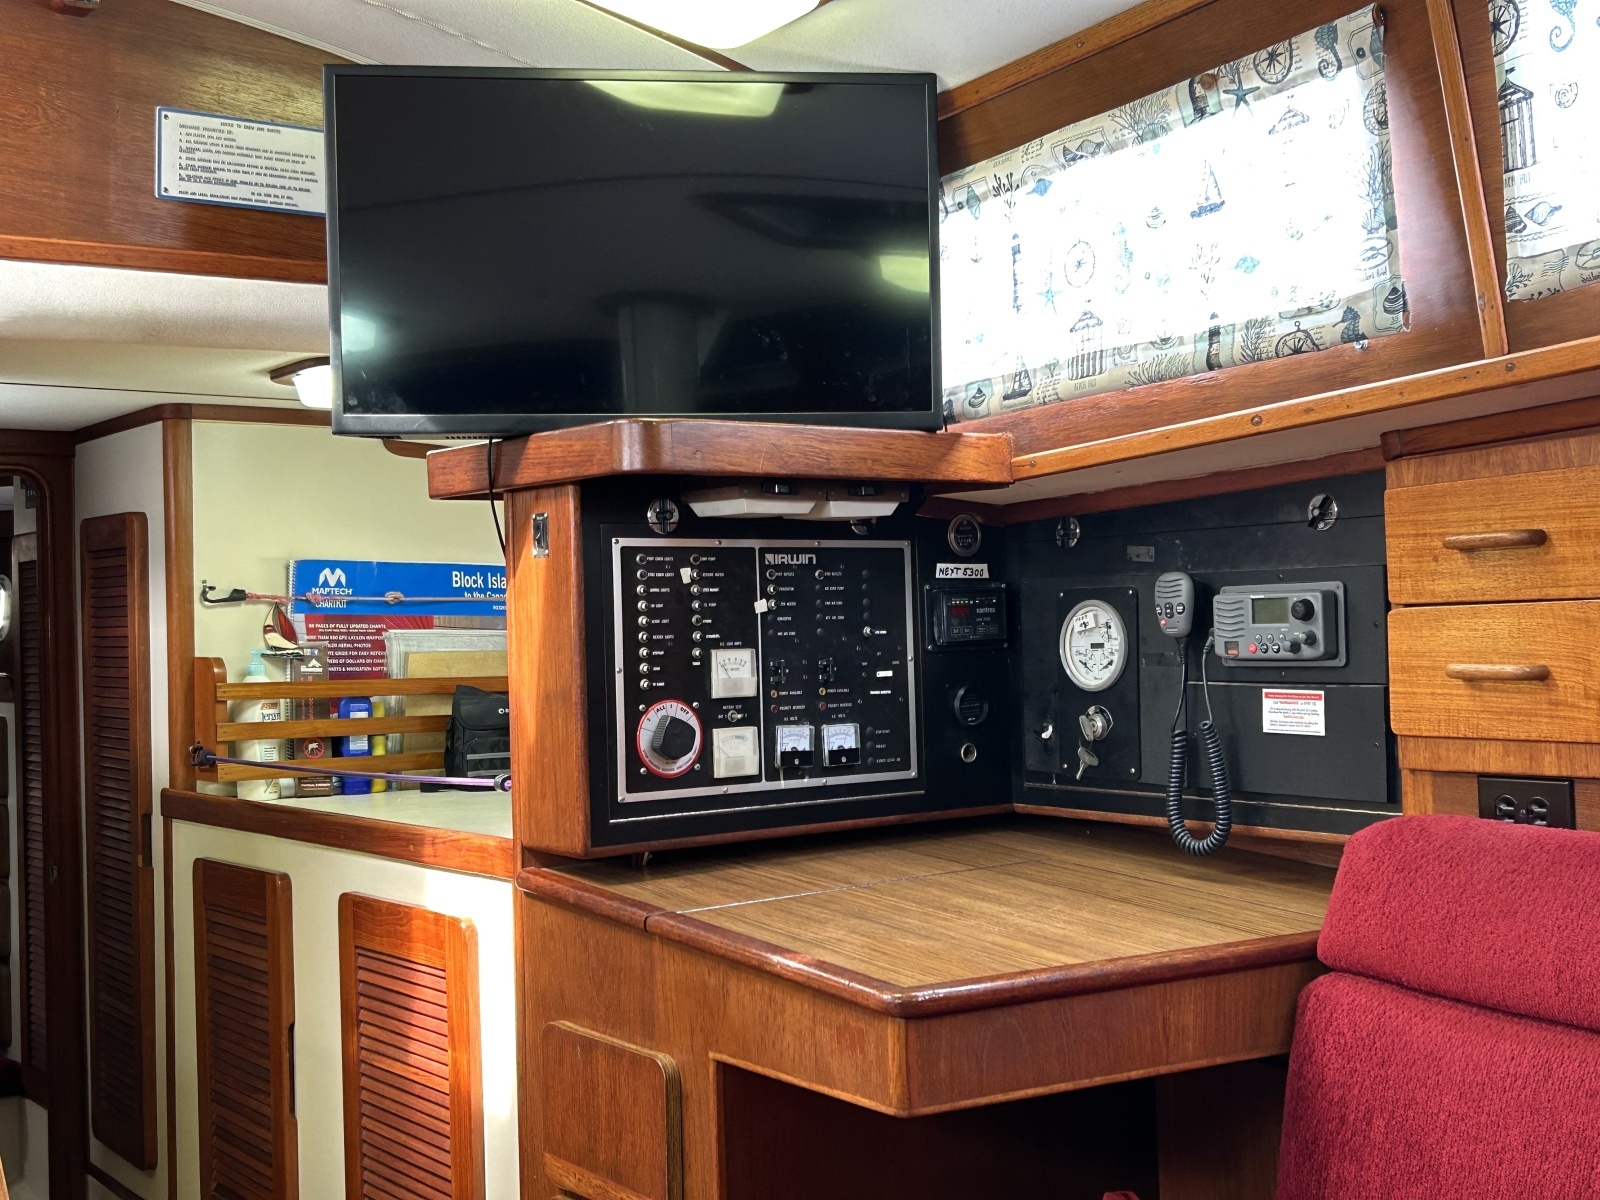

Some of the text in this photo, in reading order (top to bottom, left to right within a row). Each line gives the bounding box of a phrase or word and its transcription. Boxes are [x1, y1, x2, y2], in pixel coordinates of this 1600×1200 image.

[775, 554, 816, 564] IRWIN
[939, 567, 983, 577] NEXT 5300
[452, 571, 506, 588] Block Isla
[680, 707, 689, 715] OFF
